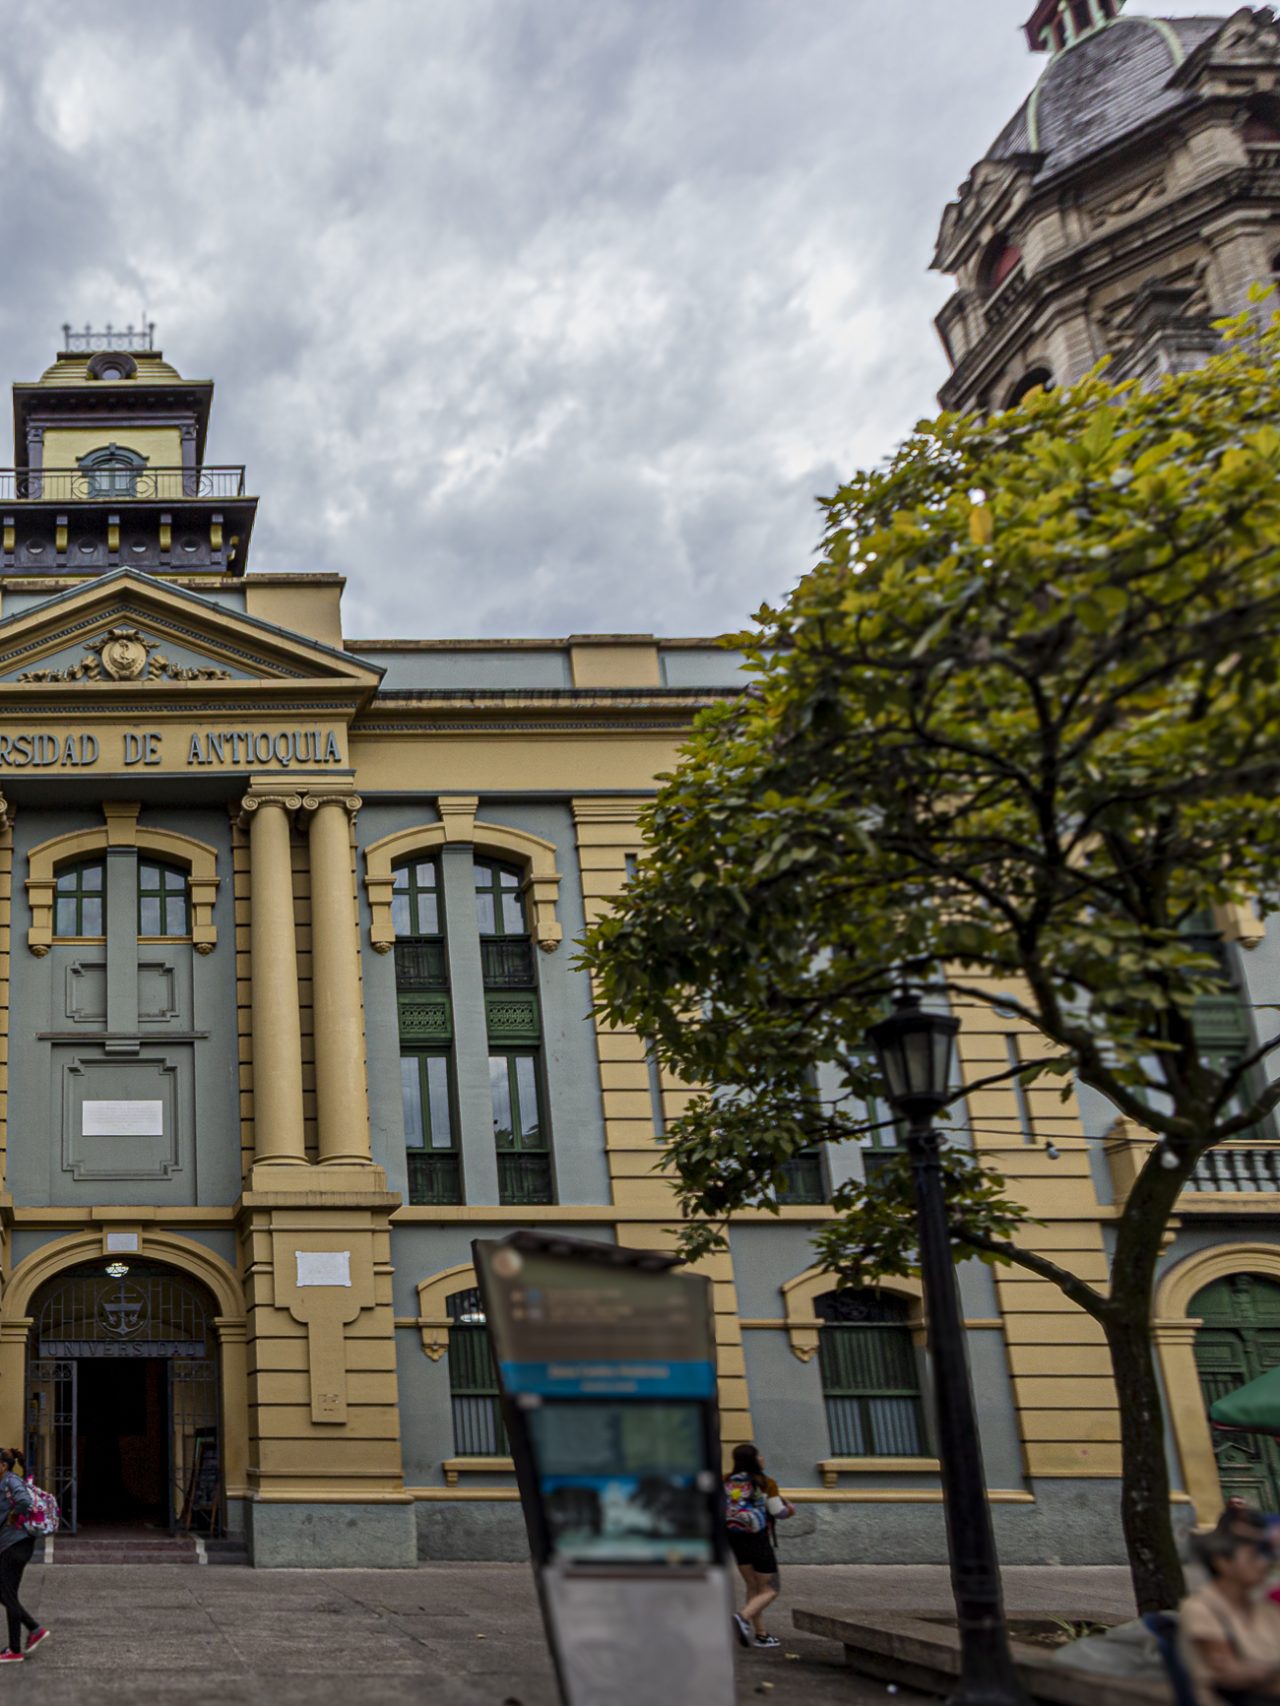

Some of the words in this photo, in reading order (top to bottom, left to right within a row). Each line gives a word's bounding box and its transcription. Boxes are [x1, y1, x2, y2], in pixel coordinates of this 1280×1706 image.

[123, 732, 162, 766] DE
[187, 729, 342, 768] ANTIOQUIA
[47, 1341, 196, 1357] UNIVERSIDAD
